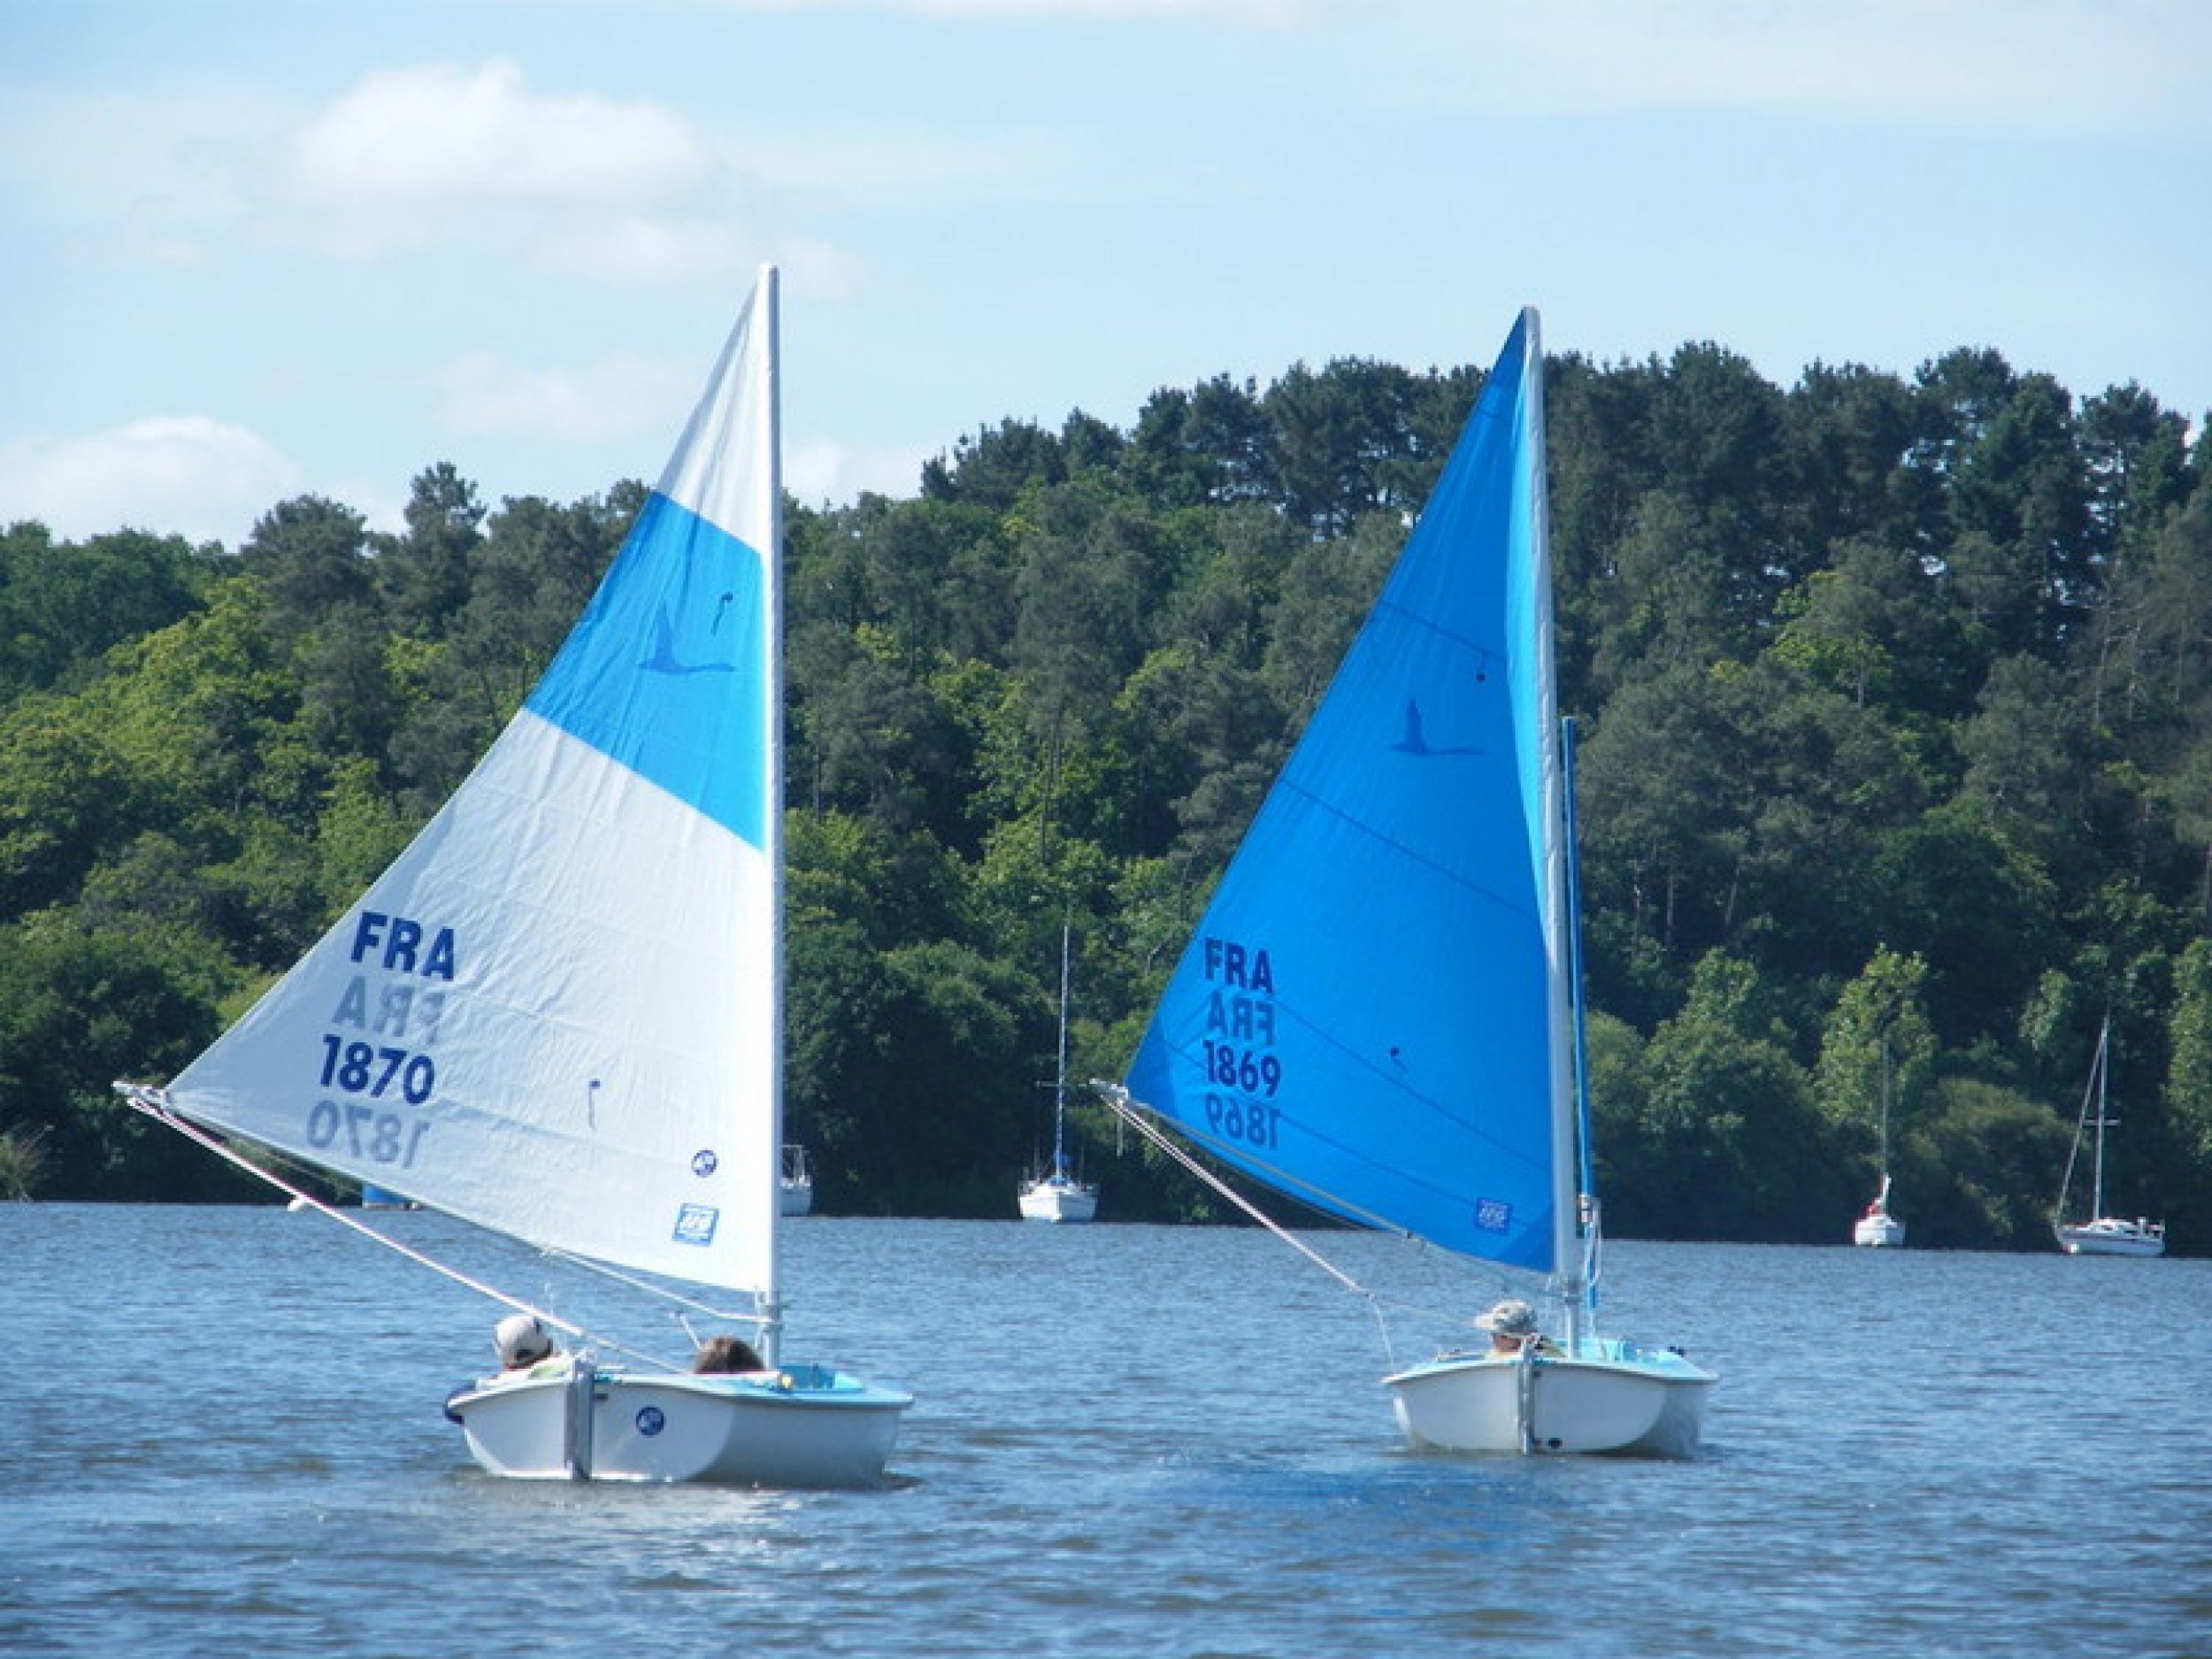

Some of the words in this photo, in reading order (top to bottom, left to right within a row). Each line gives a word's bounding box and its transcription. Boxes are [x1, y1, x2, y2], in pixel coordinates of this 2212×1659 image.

[351, 910, 454, 981] FRA
[1205, 937, 1272, 993] FRA
[320, 1033, 434, 1105] 1870
[1202, 1040, 1280, 1098] 1869
